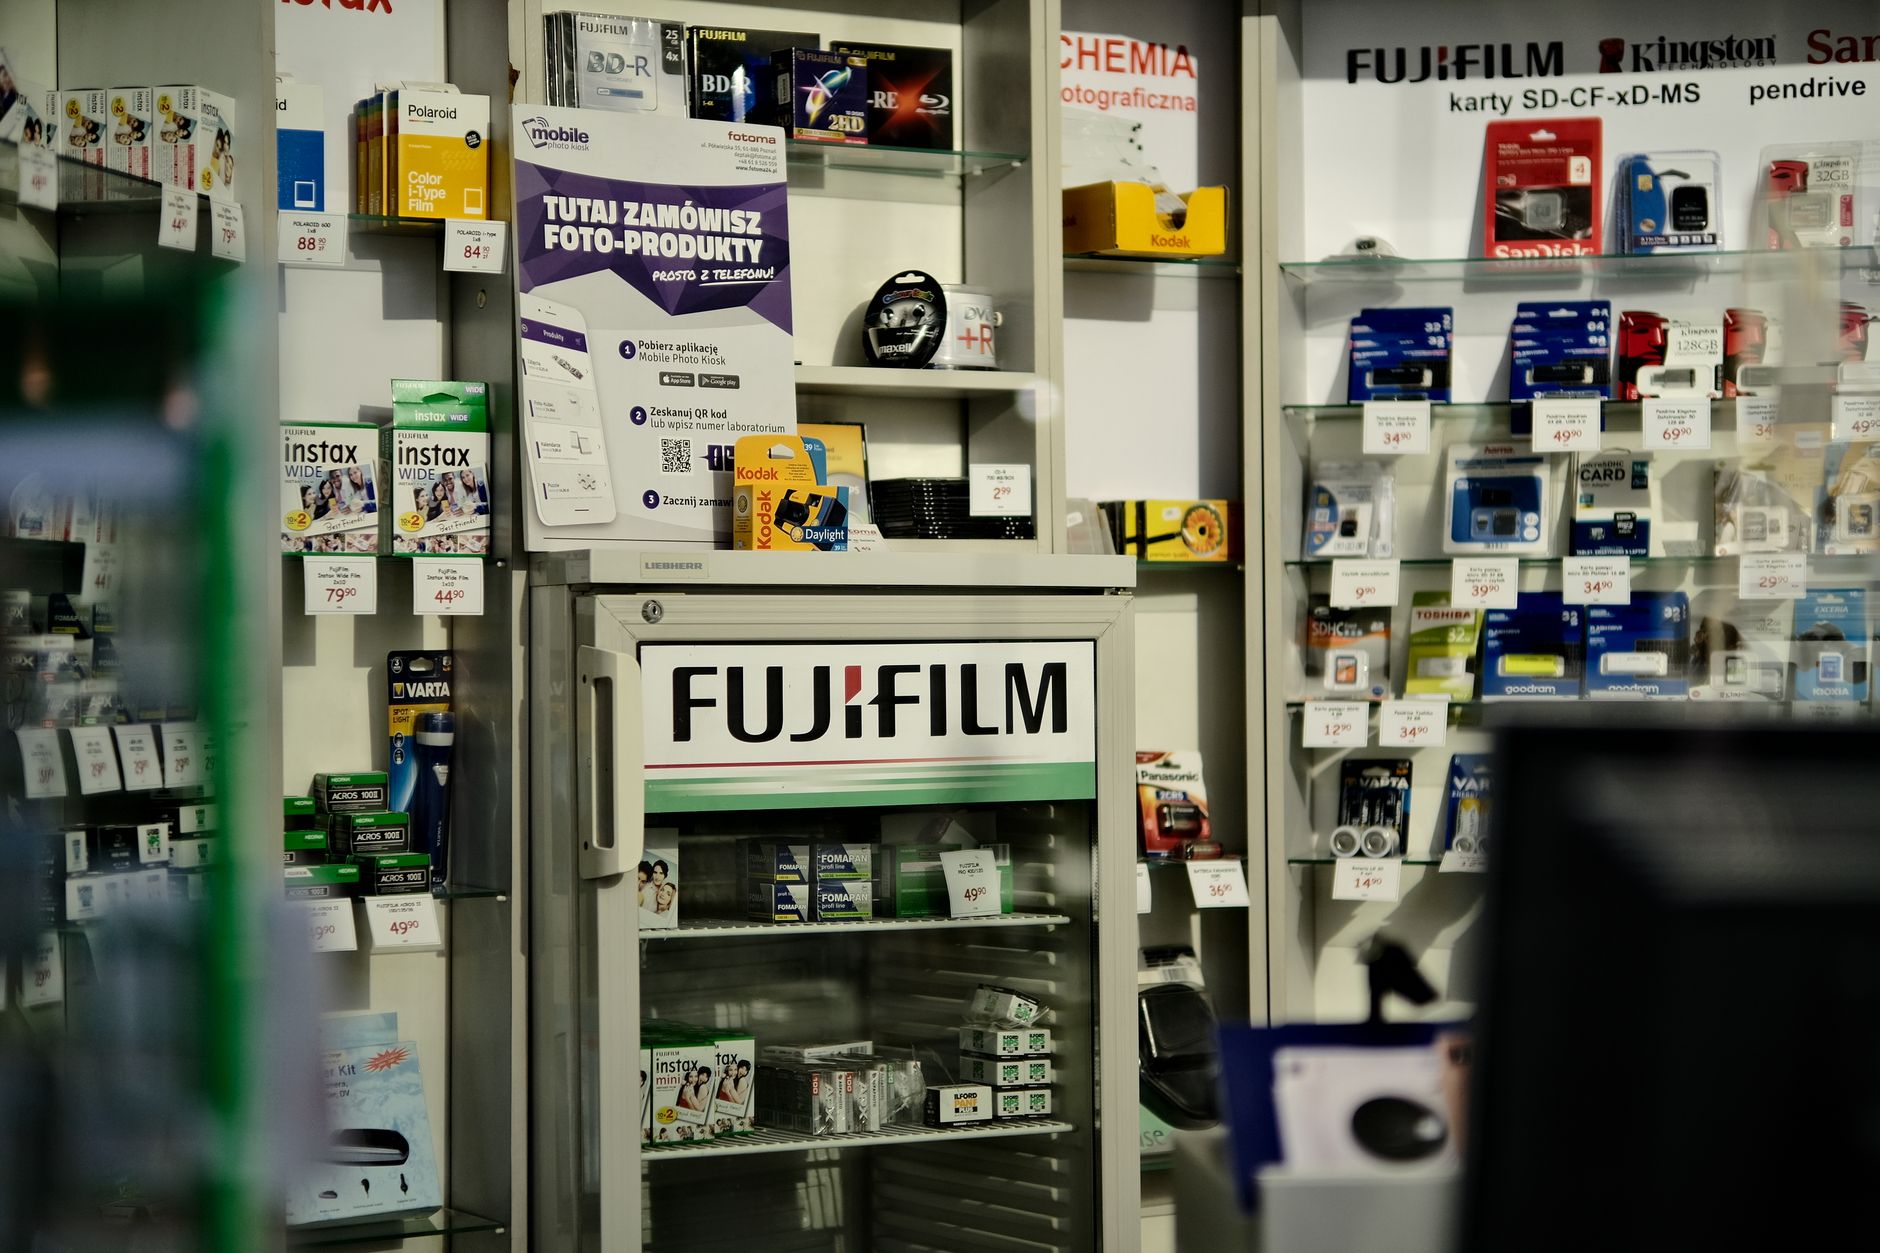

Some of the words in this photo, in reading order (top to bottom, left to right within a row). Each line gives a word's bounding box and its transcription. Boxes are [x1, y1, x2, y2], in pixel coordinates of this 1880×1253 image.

[580, 22, 628, 36] FUJIFILM
[665, 29, 678, 40] 25
[700, 29, 747, 41] FUJIFILM
[665, 51, 679, 62] 4x
[1060, 35, 1197, 78] CHEMIA
[1631, 34, 1777, 73] Kingston
[587, 50, 652, 77] BD-R
[1347, 41, 1564, 84] FUJIFILM
[1657, 59, 1778, 71] TECHNOLOGY
[1750, 76, 1867, 106] pendrive
[1450, 91, 1512, 116] karty
[1522, 82, 1701, 109] SD-CF-xD-MS
[408, 104, 457, 119] Polaroid
[828, 114, 865, 132] 2HD
[532, 127, 589, 143] mobile
[728, 131, 776, 144] fotoma
[547, 141, 569, 150] photo
[570, 142, 589, 151] kiosk
[408, 171, 442, 184] Color
[1816, 170, 1850, 182] 32GB
[408, 185, 446, 200] i-Type
[408, 199, 434, 212] Film
[543, 195, 617, 224] TUTAJ
[623, 200, 762, 235] ZAMÓWISZ
[297, 237, 316, 250] 88
[543, 224, 764, 263] FOTO-PRODUKTY
[1150, 234, 1191, 249] Kodak
[463, 246, 481, 259] 84
[652, 270, 696, 282] PROSTO
[700, 269, 709, 280] Z
[713, 266, 774, 280] TELEFONU!
[543, 329, 564, 342] Produkty
[638, 340, 674, 351] Pobierz
[675, 343, 718, 355] aplikację
[879, 343, 913, 353] maxell
[1677, 340, 1719, 351] 128GB
[638, 352, 670, 363] Mobile
[672, 353, 699, 364] Photo
[701, 355, 726, 366] Kiosk
[415, 410, 446, 422] instax
[650, 407, 693, 420] Zeskanuj
[694, 409, 709, 418] QR
[711, 409, 727, 419] kod
[650, 418, 666, 428] lub
[667, 420, 694, 431] wpisz
[696, 423, 725, 431] numer
[727, 422, 786, 433] laboratorium
[284, 436, 358, 465] instax
[398, 440, 470, 467] instax
[805, 443, 813, 451] 39
[1581, 460, 1624, 468] microSDHC
[284, 466, 323, 478] WIDE
[398, 468, 435, 481] WIDE
[736, 466, 779, 481] Kodak
[1580, 469, 1626, 482] CARD
[663, 495, 697, 508] Zacznij
[324, 518, 340, 531] Best
[341, 515, 365, 529] Friends!
[438, 520, 453, 532] Best
[454, 516, 478, 530] Friends!
[757, 489, 772, 549] Kodak
[805, 528, 845, 543] Daylight
[645, 562, 703, 570] LIEBHERR
[1417, 610, 1472, 620] TOSHIBA
[1814, 606, 1849, 614] EXCERIA
[1311, 621, 1344, 637] SDHC
[1449, 627, 1466, 642] 32
[406, 682, 450, 698] VARTA
[1505, 684, 1556, 695] goodram
[1812, 687, 1849, 696] KIOXIA
[672, 662, 1068, 743] FUJIFILM
[393, 716, 409, 724] LIGHT
[1141, 770, 1199, 782] Panasonic
[1360, 777, 1409, 789] VARTA
[332, 792, 358, 800] ACROS
[356, 833, 382, 841] ACROS
[821, 854, 868, 863] FOMAPAN
[380, 874, 405, 882] ACROS
[821, 893, 868, 903] FOMAPAN
[338, 1064, 357, 1077] Kit
[656, 1058, 698, 1073] instax
[656, 1074, 681, 1085] mini
[340, 1089, 350, 1097] DV
[954, 1092, 978, 1100] ILFORD
